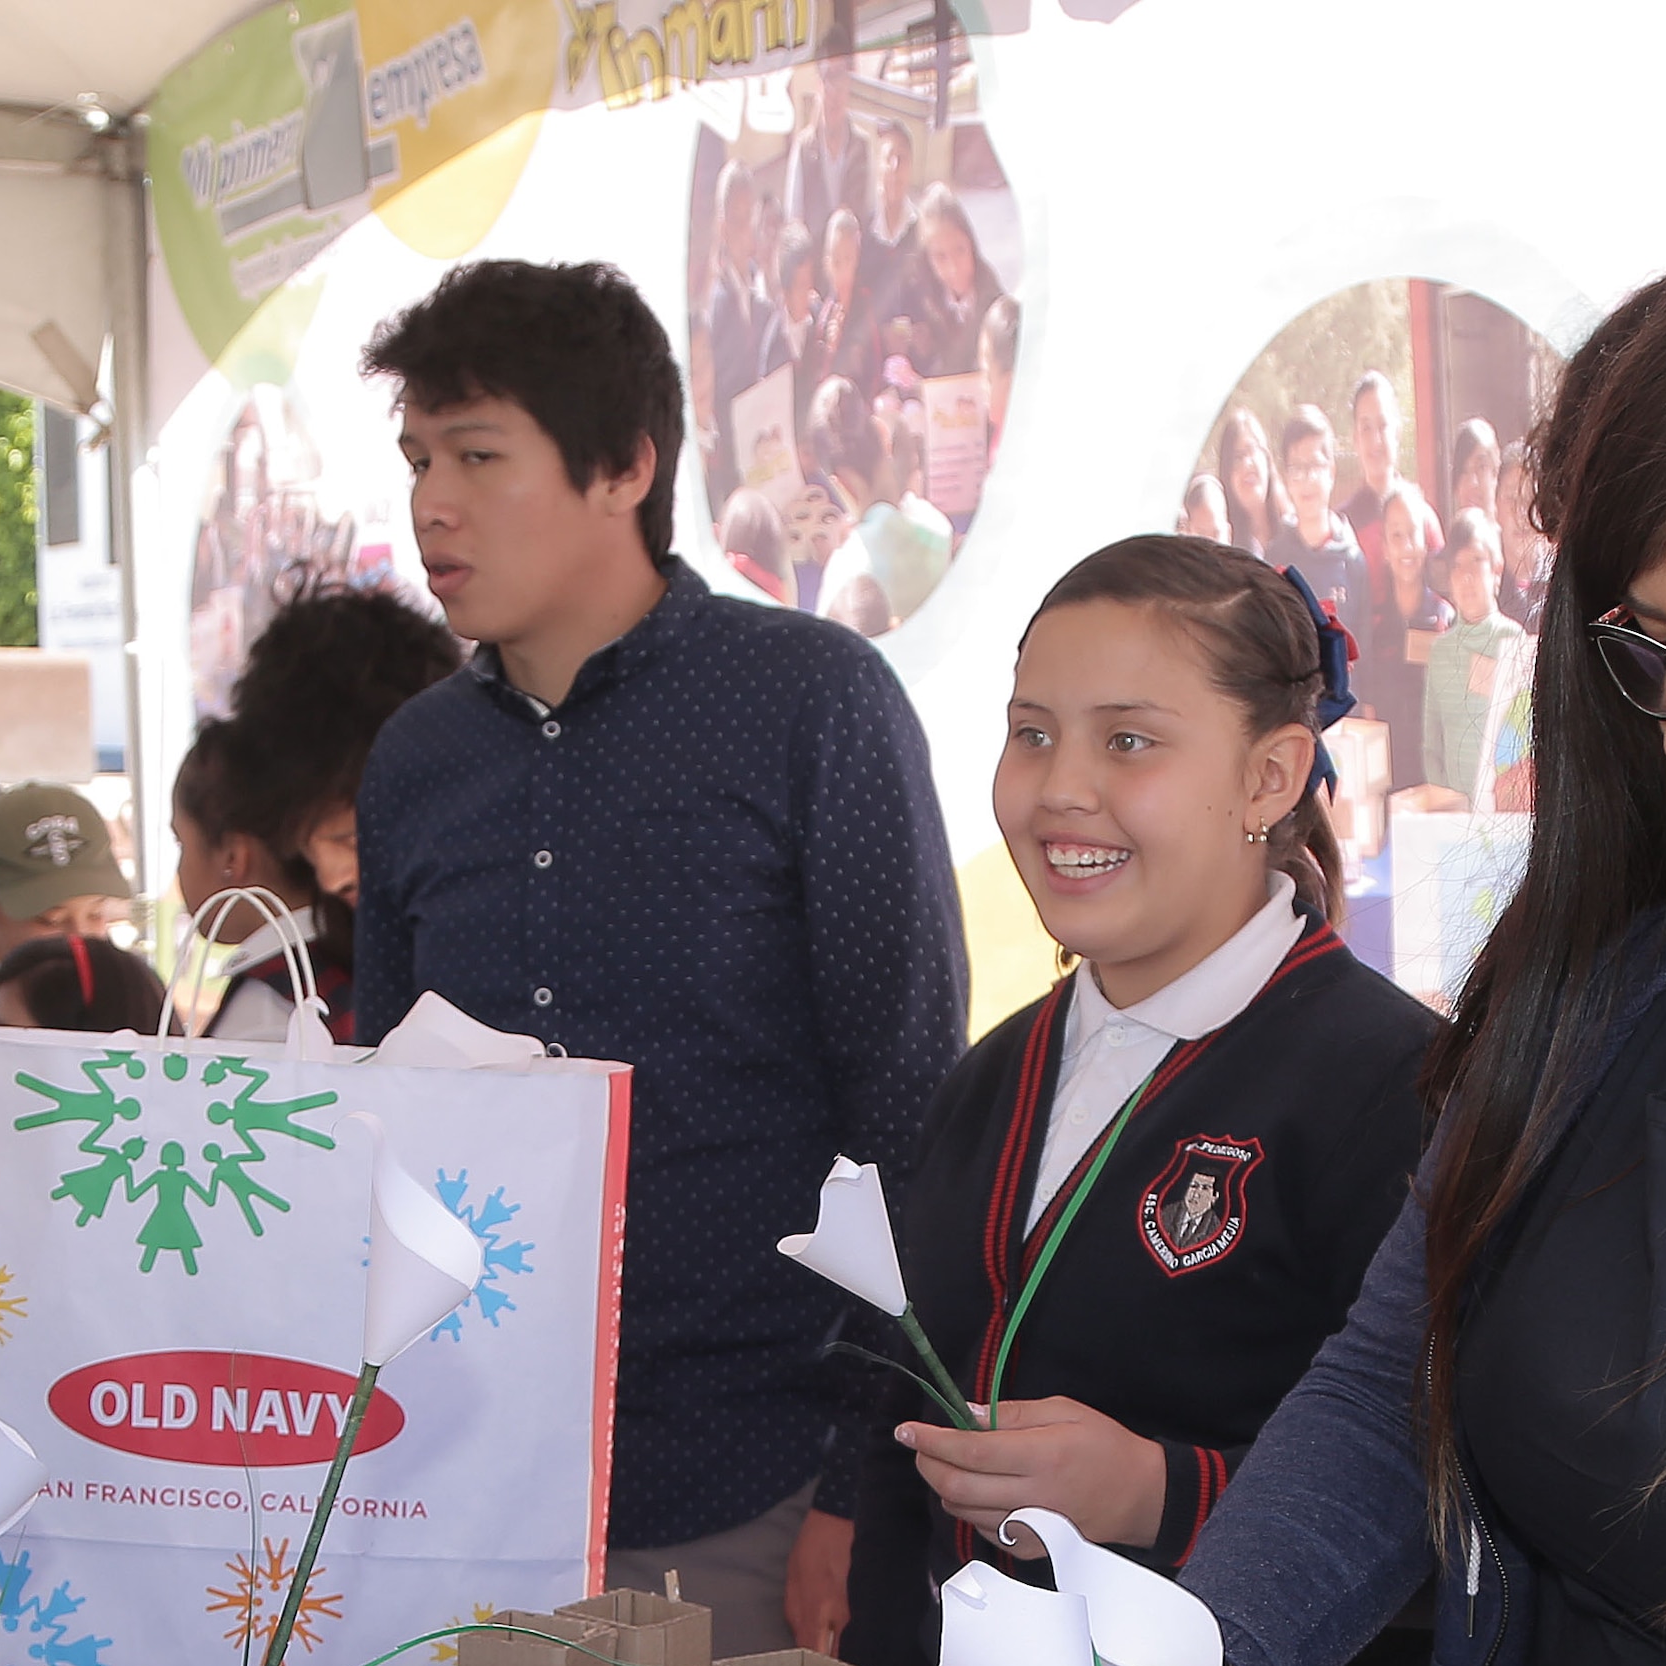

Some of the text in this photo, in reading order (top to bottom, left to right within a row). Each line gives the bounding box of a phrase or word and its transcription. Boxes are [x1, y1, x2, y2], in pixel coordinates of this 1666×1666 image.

[369, 23, 484, 126] empresa
[1182, 1245, 1221, 1267] GARCIA
[1218, 1216, 1241, 1250] MEJIA
[89, 1379, 356, 1438] OLD NAVY
[37, 1480, 428, 1518] AN FRANCISCO, CALORNIA
